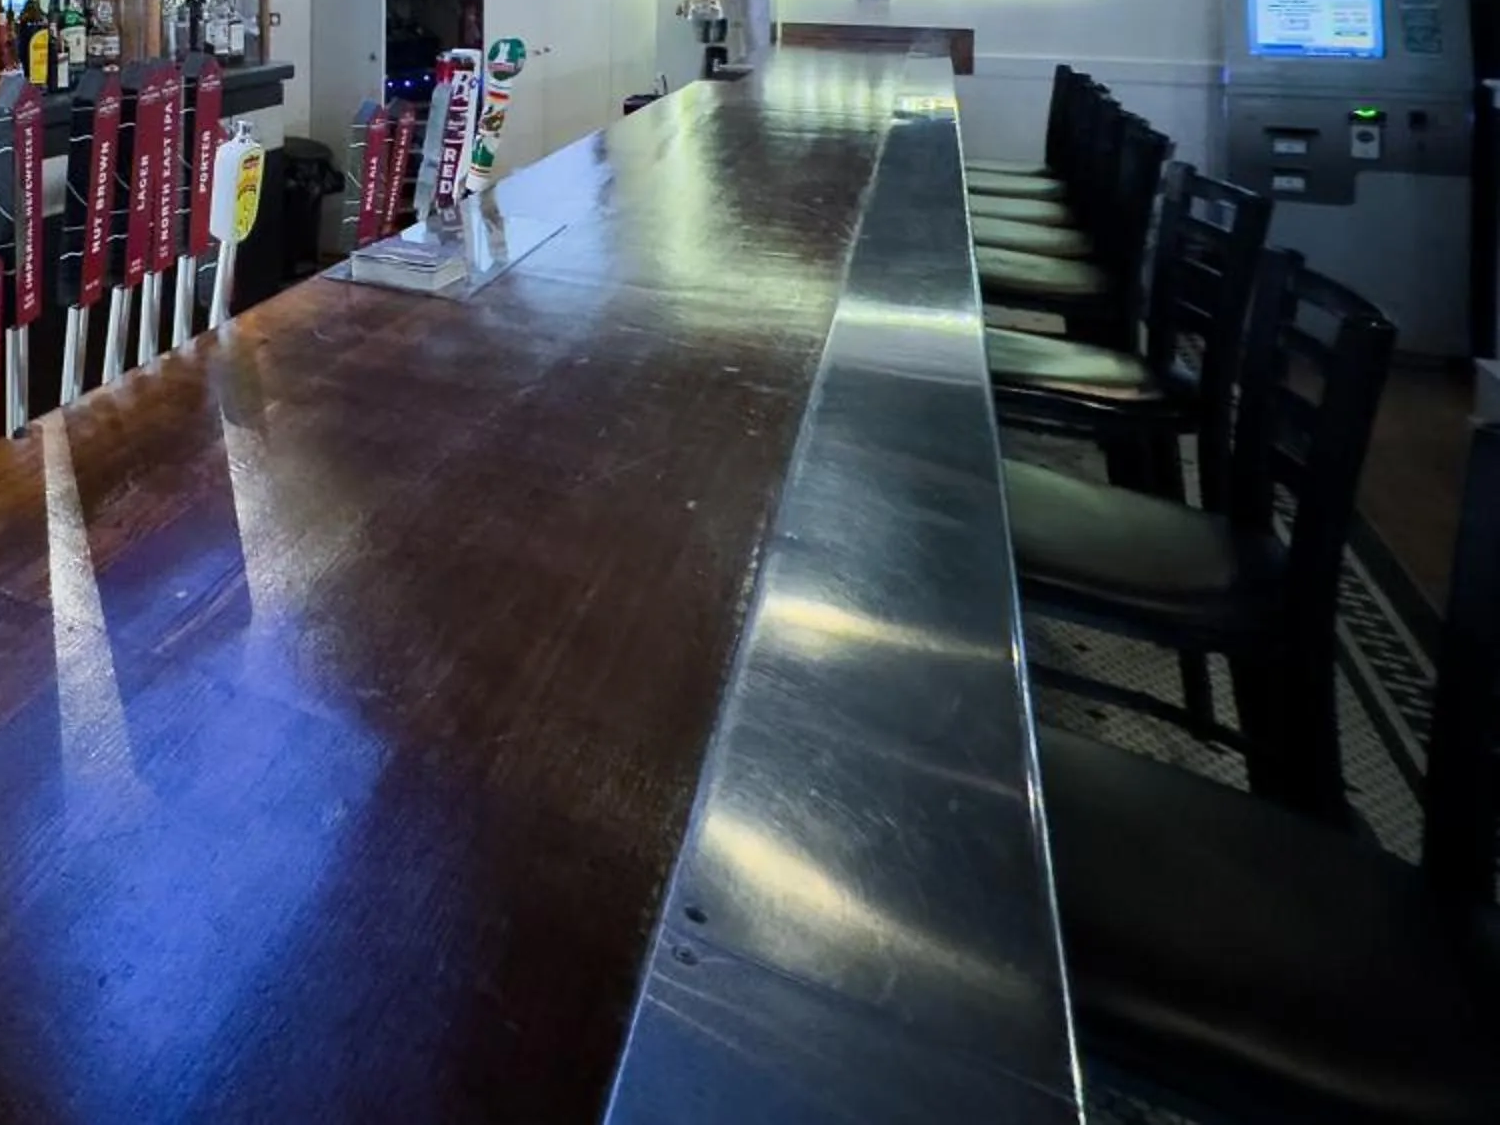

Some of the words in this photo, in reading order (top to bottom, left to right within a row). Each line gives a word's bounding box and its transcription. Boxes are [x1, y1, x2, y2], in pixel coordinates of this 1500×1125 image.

[162, 103, 172, 131] IPA
[24, 127, 34, 215] HEFEWEIZEN
[95, 142, 109, 210] BROWN
[137, 156, 148, 210] LAGER
[163, 139, 172, 177] EAST
[199, 130, 211, 192] PORTER
[370, 157, 378, 178] ALE
[440, 148, 456, 194] RED
[161, 183, 171, 241] NORTH
[366, 181, 375, 211] PALE
[23, 220, 34, 288] IMPERIAL
[92, 217, 103, 252] NUT
